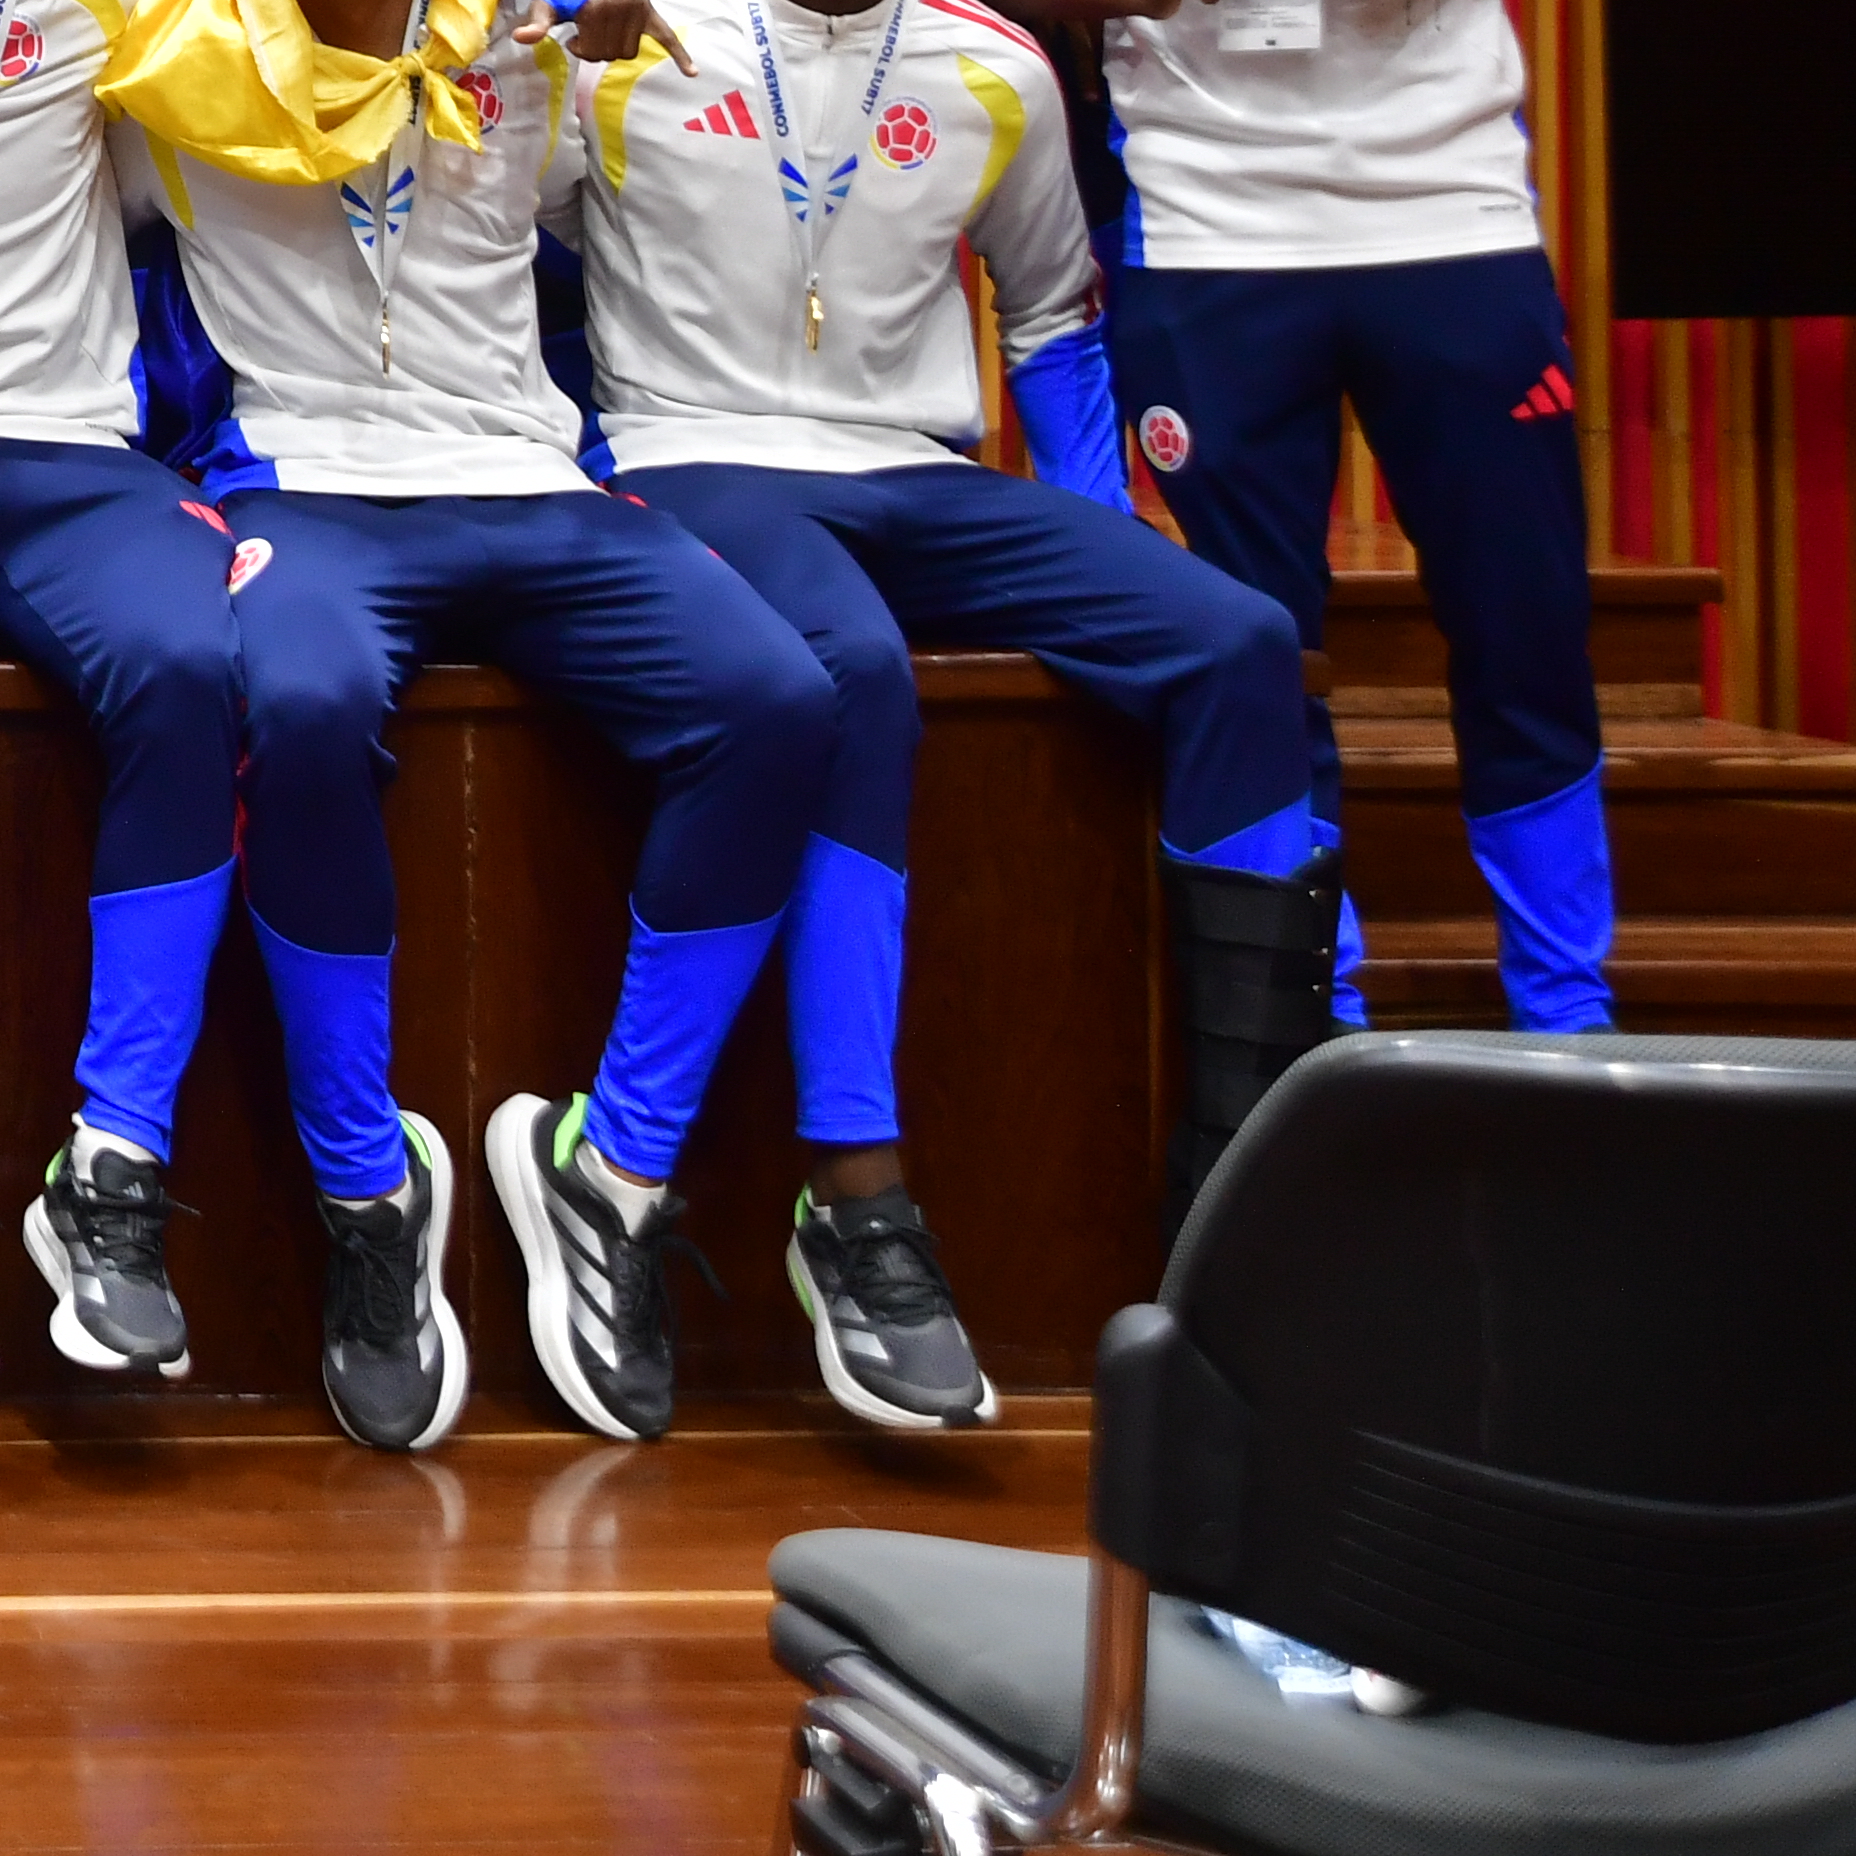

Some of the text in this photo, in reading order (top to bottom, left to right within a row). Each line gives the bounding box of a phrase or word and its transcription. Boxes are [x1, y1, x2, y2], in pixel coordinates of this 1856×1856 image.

[747, 1, 789, 138] CONMEBOL SUB17
[861, 65, 885, 116] SUB17
